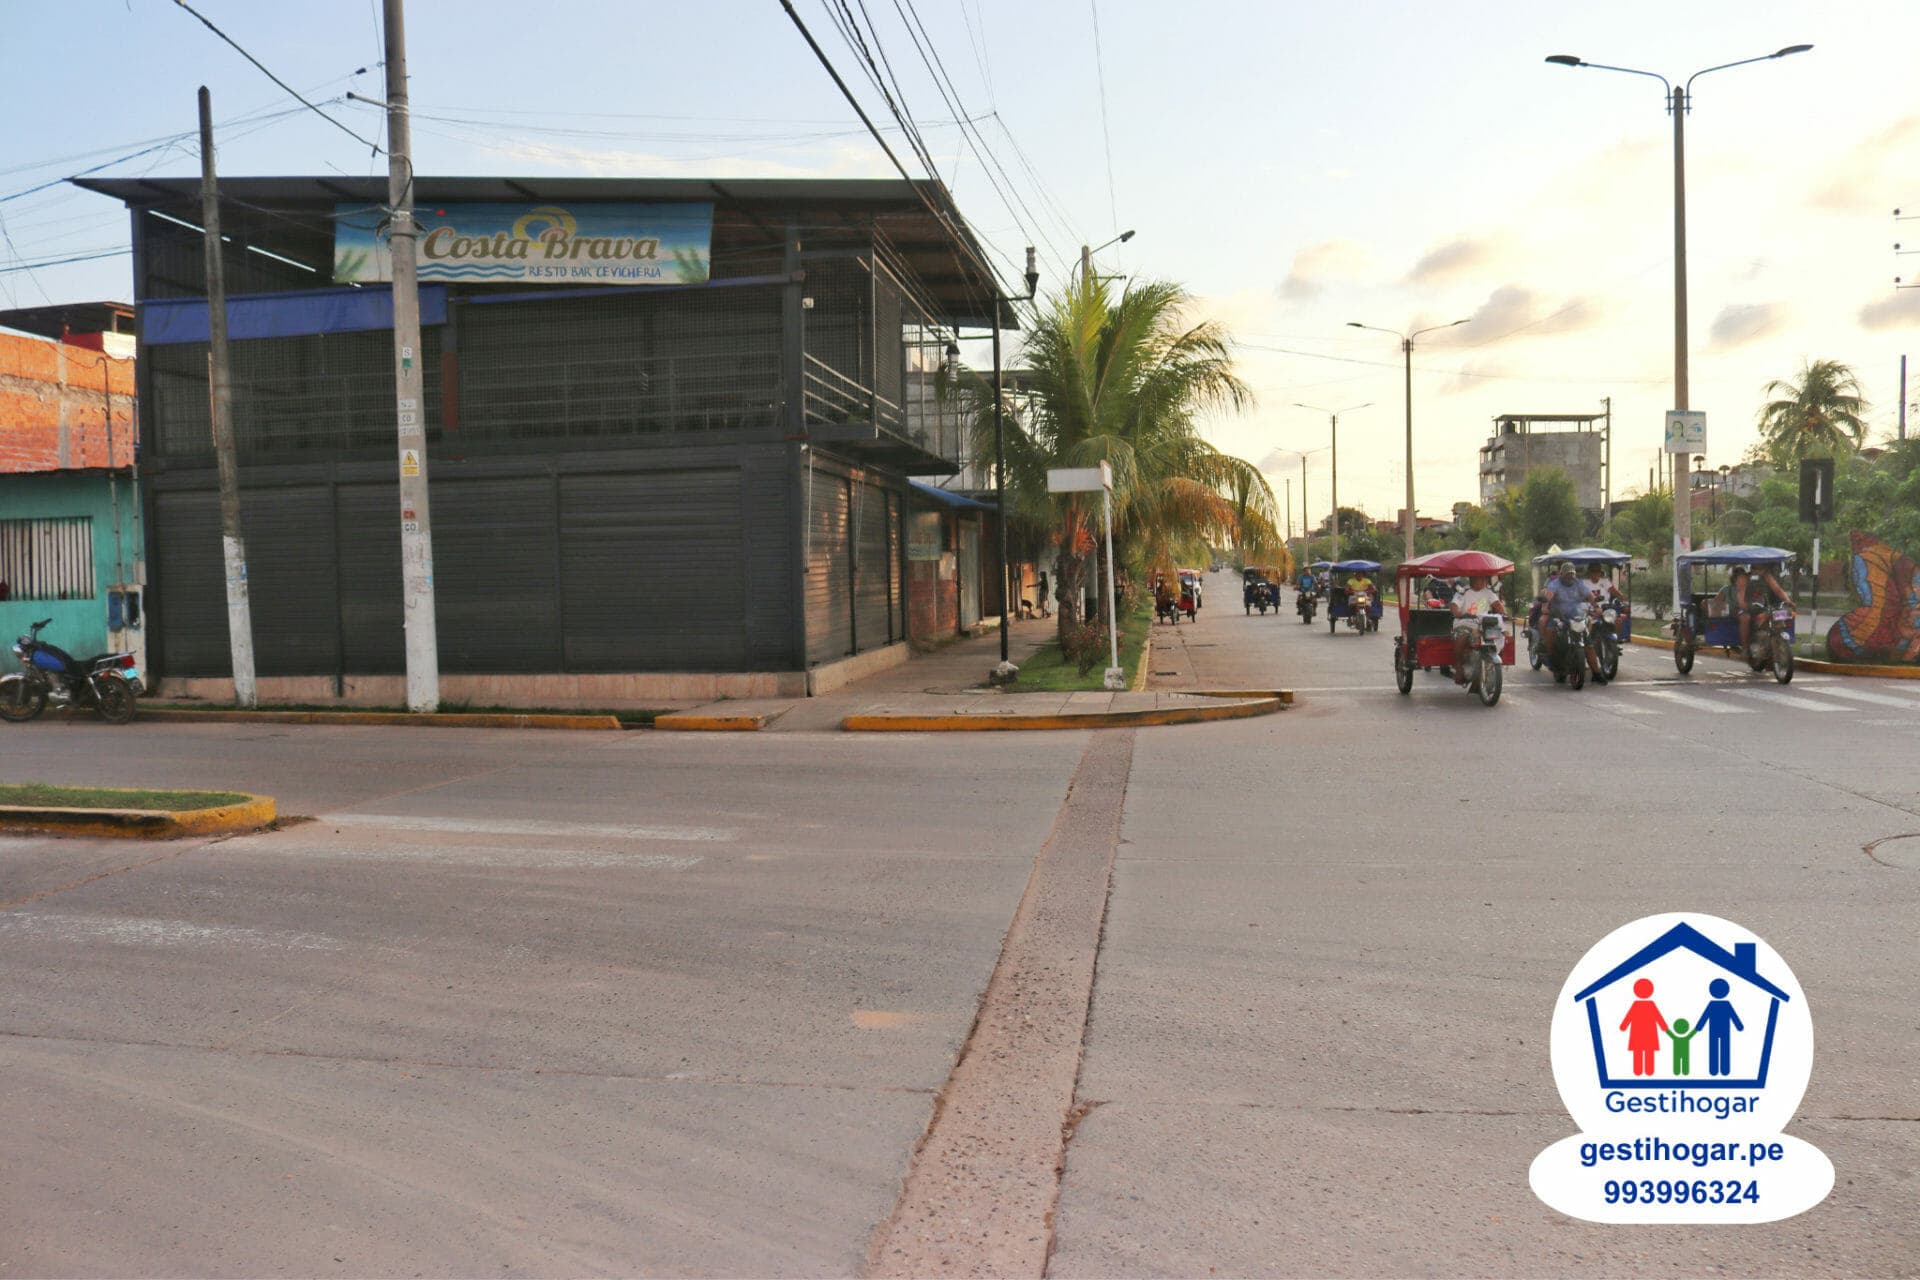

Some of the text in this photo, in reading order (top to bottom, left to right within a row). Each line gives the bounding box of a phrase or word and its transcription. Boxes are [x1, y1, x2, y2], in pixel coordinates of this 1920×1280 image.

[424, 226, 658, 259] Costa Brava
[528, 266, 662, 278] RESTO BAR CEVICHERIA
